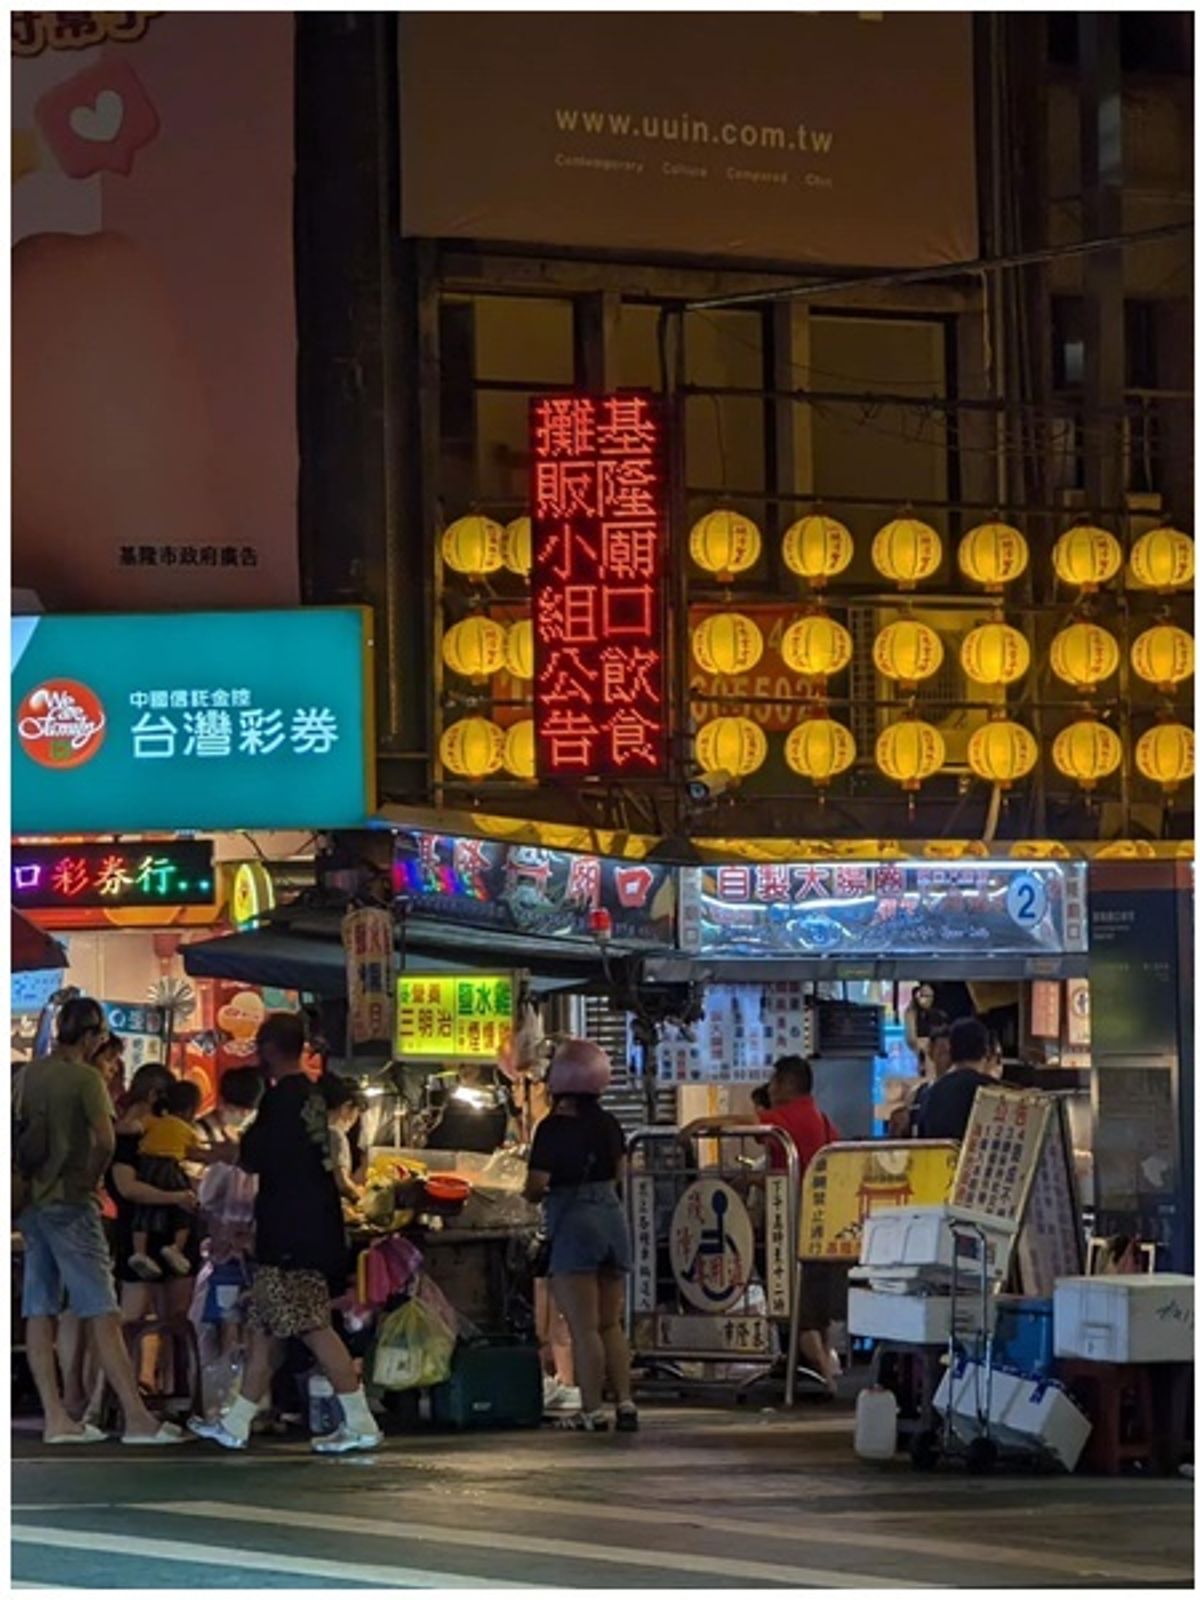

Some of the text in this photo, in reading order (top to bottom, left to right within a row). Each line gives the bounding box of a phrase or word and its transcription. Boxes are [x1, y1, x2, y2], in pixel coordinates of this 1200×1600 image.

[555, 106, 833, 153] www.uuin.com.tw
[118, 544, 259, 568] 基隆市政府廣告
[534, 398, 598, 768] 攤販小組公告
[596, 397, 659, 768] 基隆廟口飲食
[129, 688, 252, 709] 中國信託金控
[130, 708, 339, 759] 台灣彩券
[1017, 884, 1036, 919] 2
[400, 1008, 452, 1038] 三明治
